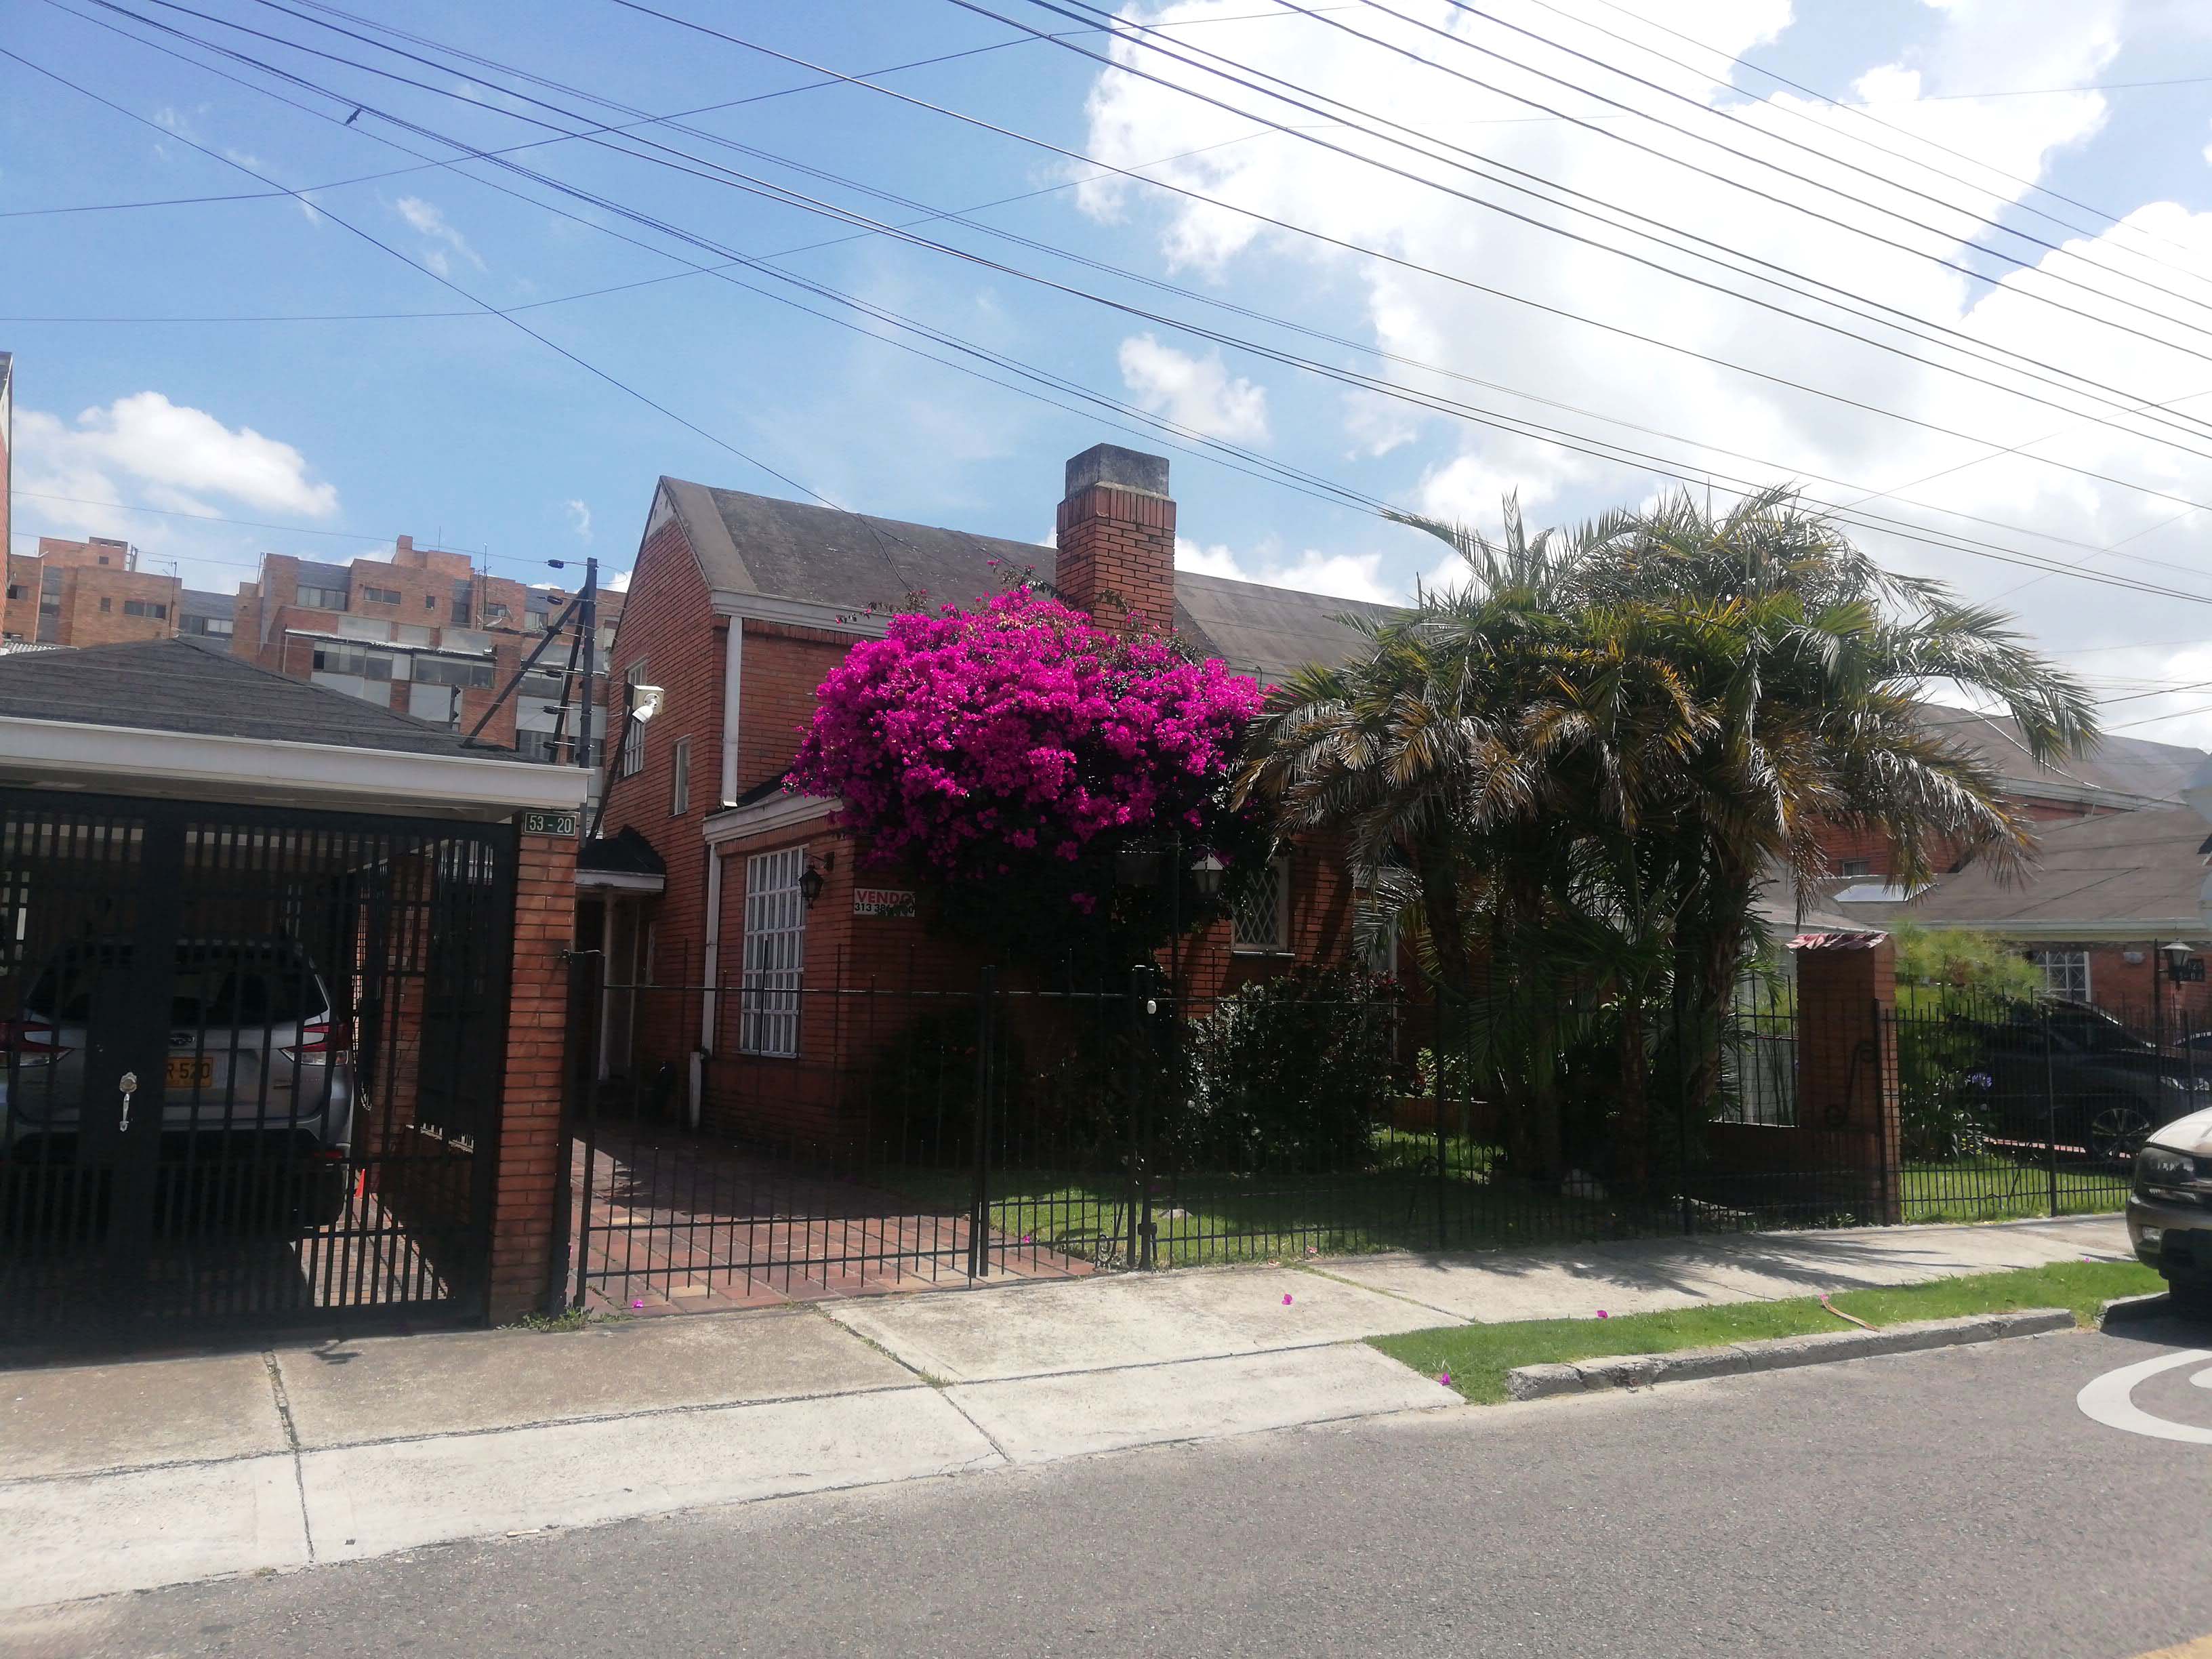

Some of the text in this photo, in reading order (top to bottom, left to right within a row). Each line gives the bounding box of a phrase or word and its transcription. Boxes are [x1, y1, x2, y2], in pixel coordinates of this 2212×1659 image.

[529, 815, 544, 831] 53
[556, 817, 572, 834] 20
[857, 890, 912, 905] VENDO
[855, 903, 872, 912] 313
